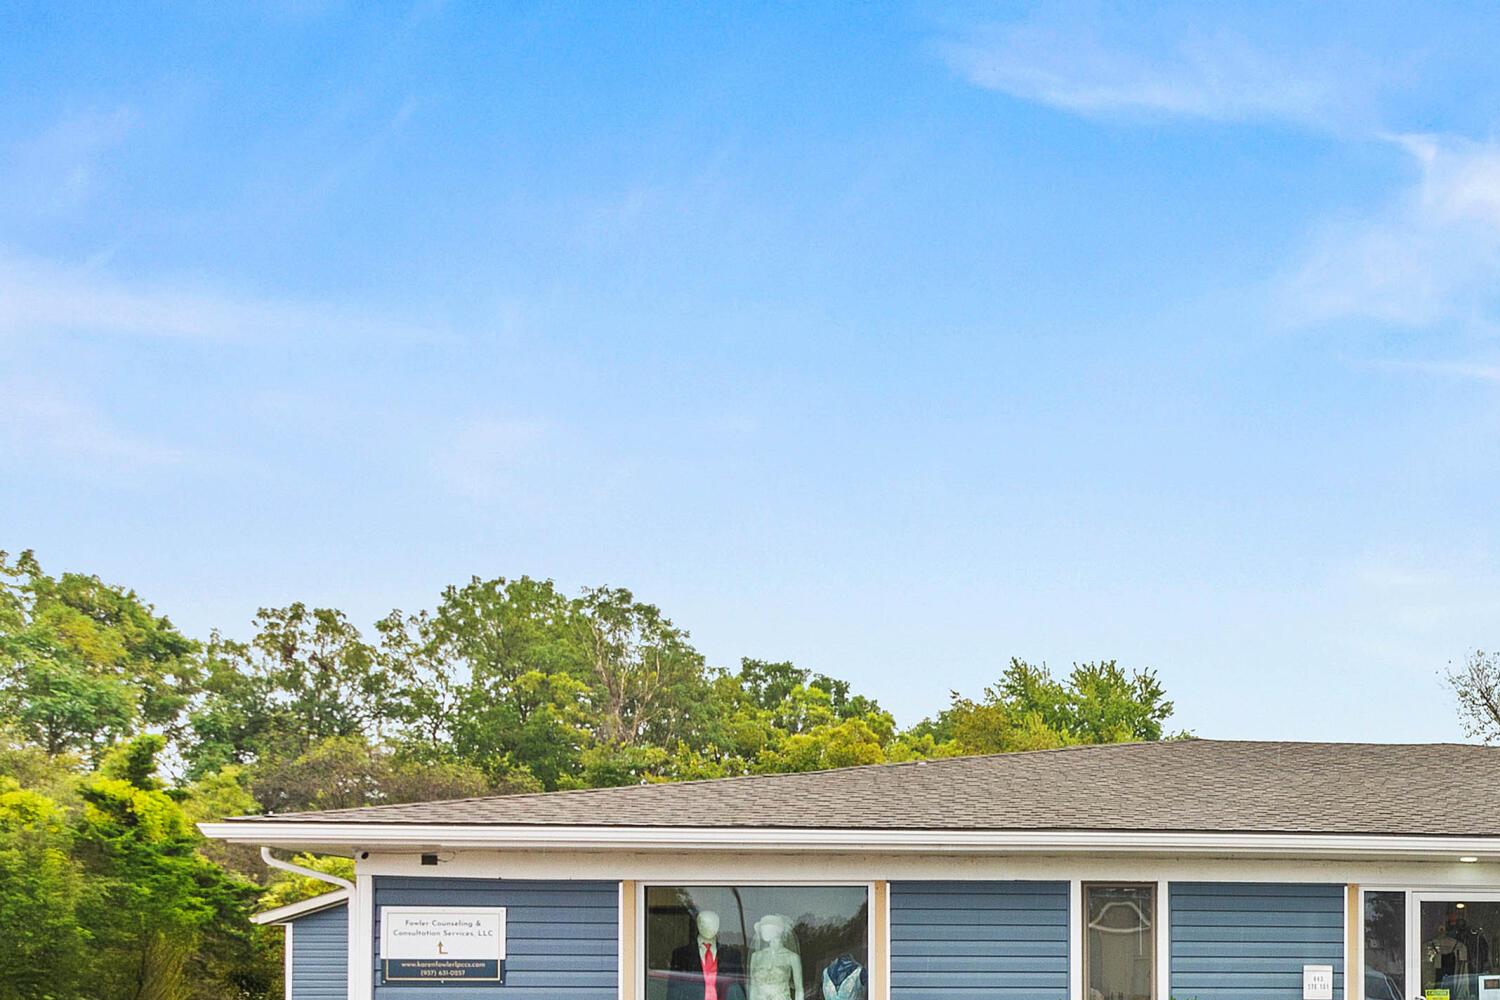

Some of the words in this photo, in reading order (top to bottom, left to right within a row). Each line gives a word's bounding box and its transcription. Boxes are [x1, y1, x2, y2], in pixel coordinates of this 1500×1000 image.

[431, 919, 473, 928] Counseling
[393, 929, 441, 937] Consultation
[478, 929, 493, 937] LLC
